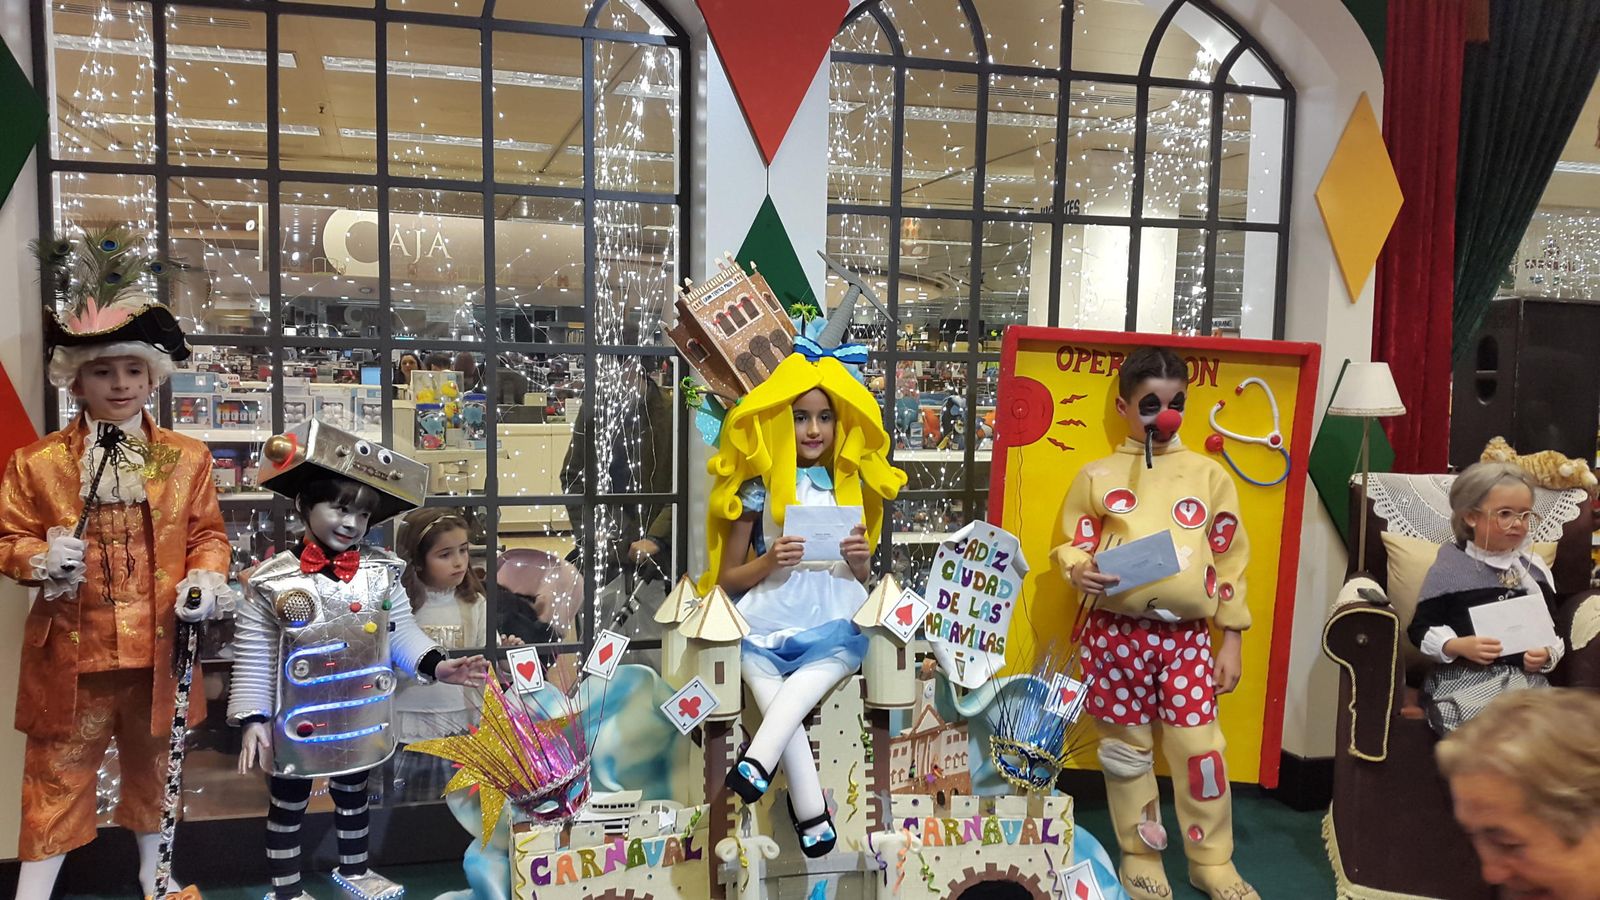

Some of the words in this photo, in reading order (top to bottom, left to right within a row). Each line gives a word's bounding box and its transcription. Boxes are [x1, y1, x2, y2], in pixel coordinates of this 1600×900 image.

[1056, 345, 1220, 387] OPERON
[941, 559, 1013, 600] CIUDAD
[936, 588, 961, 615] DE
[968, 596, 1003, 624] LAS
[924, 612, 1005, 656] MARAVILLAS
[902, 815, 1060, 847] CARNAVAL
[530, 837, 703, 887] CARNAVAL
